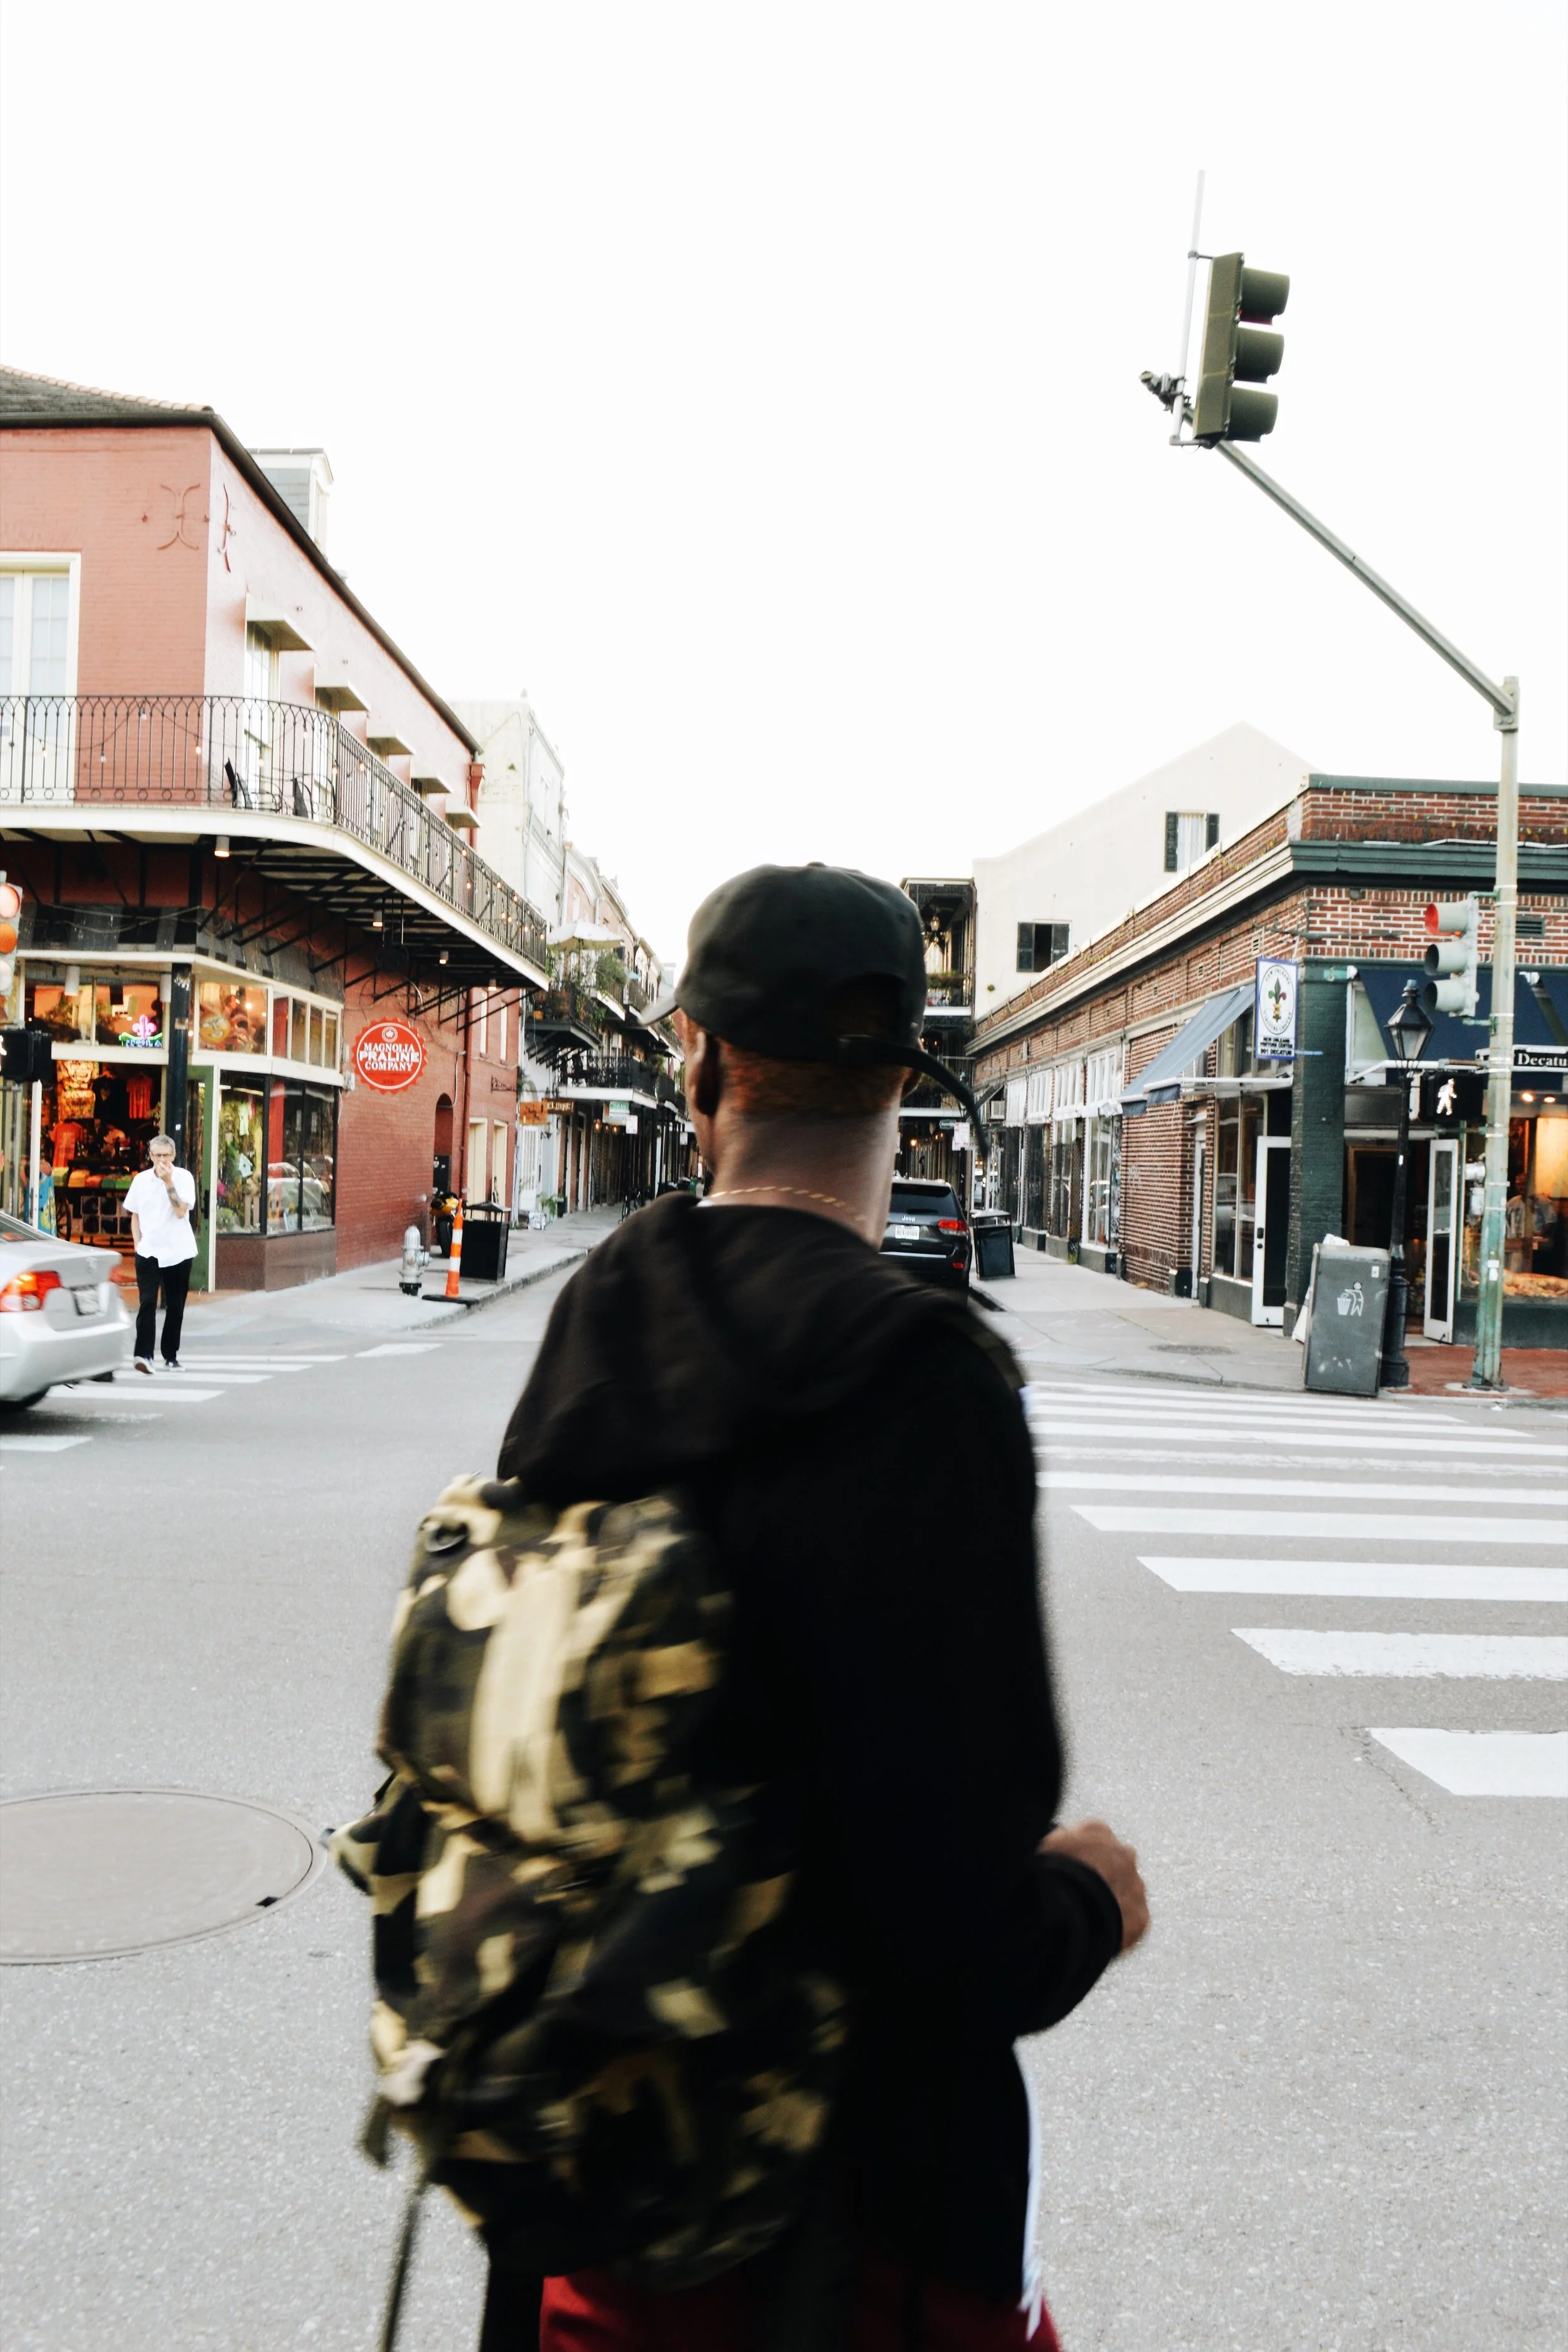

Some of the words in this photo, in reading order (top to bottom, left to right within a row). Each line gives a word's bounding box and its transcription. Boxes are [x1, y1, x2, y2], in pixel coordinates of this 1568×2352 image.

[364, 1042, 415, 1052] MAGNOLIA
[359, 1050, 420, 1062] PRALINE
[1518, 1053, 1568, 1066] Decatu
[364, 1061, 413, 1071] COMPANY
